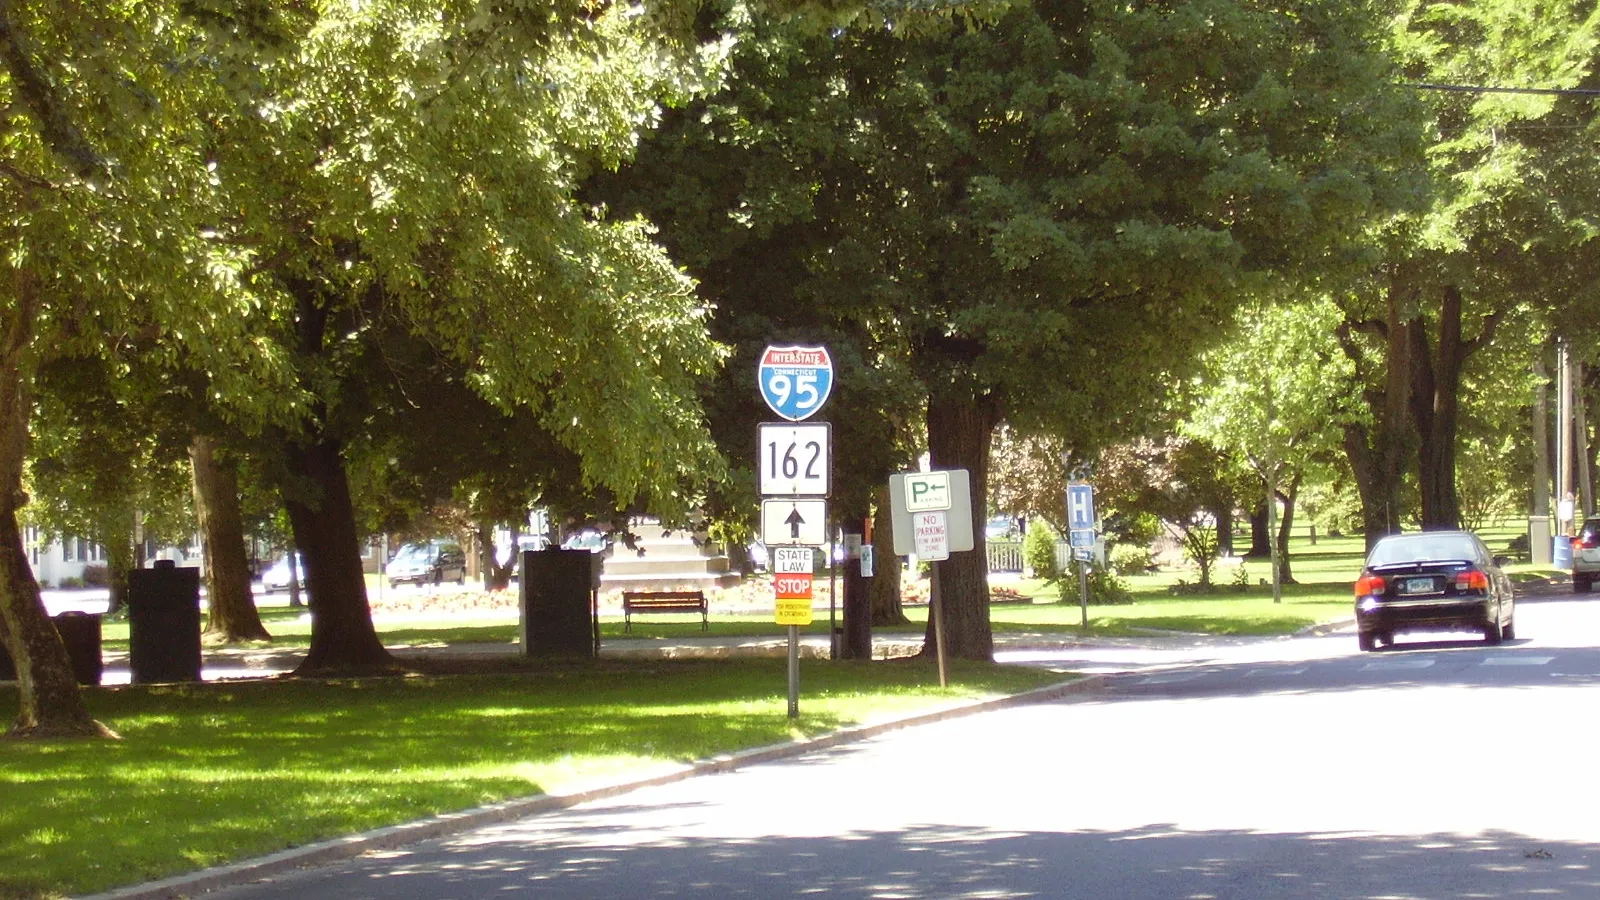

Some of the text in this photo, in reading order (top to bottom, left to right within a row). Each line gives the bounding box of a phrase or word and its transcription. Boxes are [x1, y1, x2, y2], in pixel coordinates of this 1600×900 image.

[771, 353, 821, 364] INTERSTATE
[774, 368, 817, 376] CONNECTICUT
[769, 375, 818, 409] 95
[768, 441, 821, 479] 162
[912, 481, 929, 503] P
[1072, 492, 1087, 523] H
[923, 515, 937, 525] NO
[917, 526, 945, 536] PARKING
[778, 550, 810, 560] STATE
[782, 562, 805, 572] LAW
[777, 579, 810, 594] STOP
